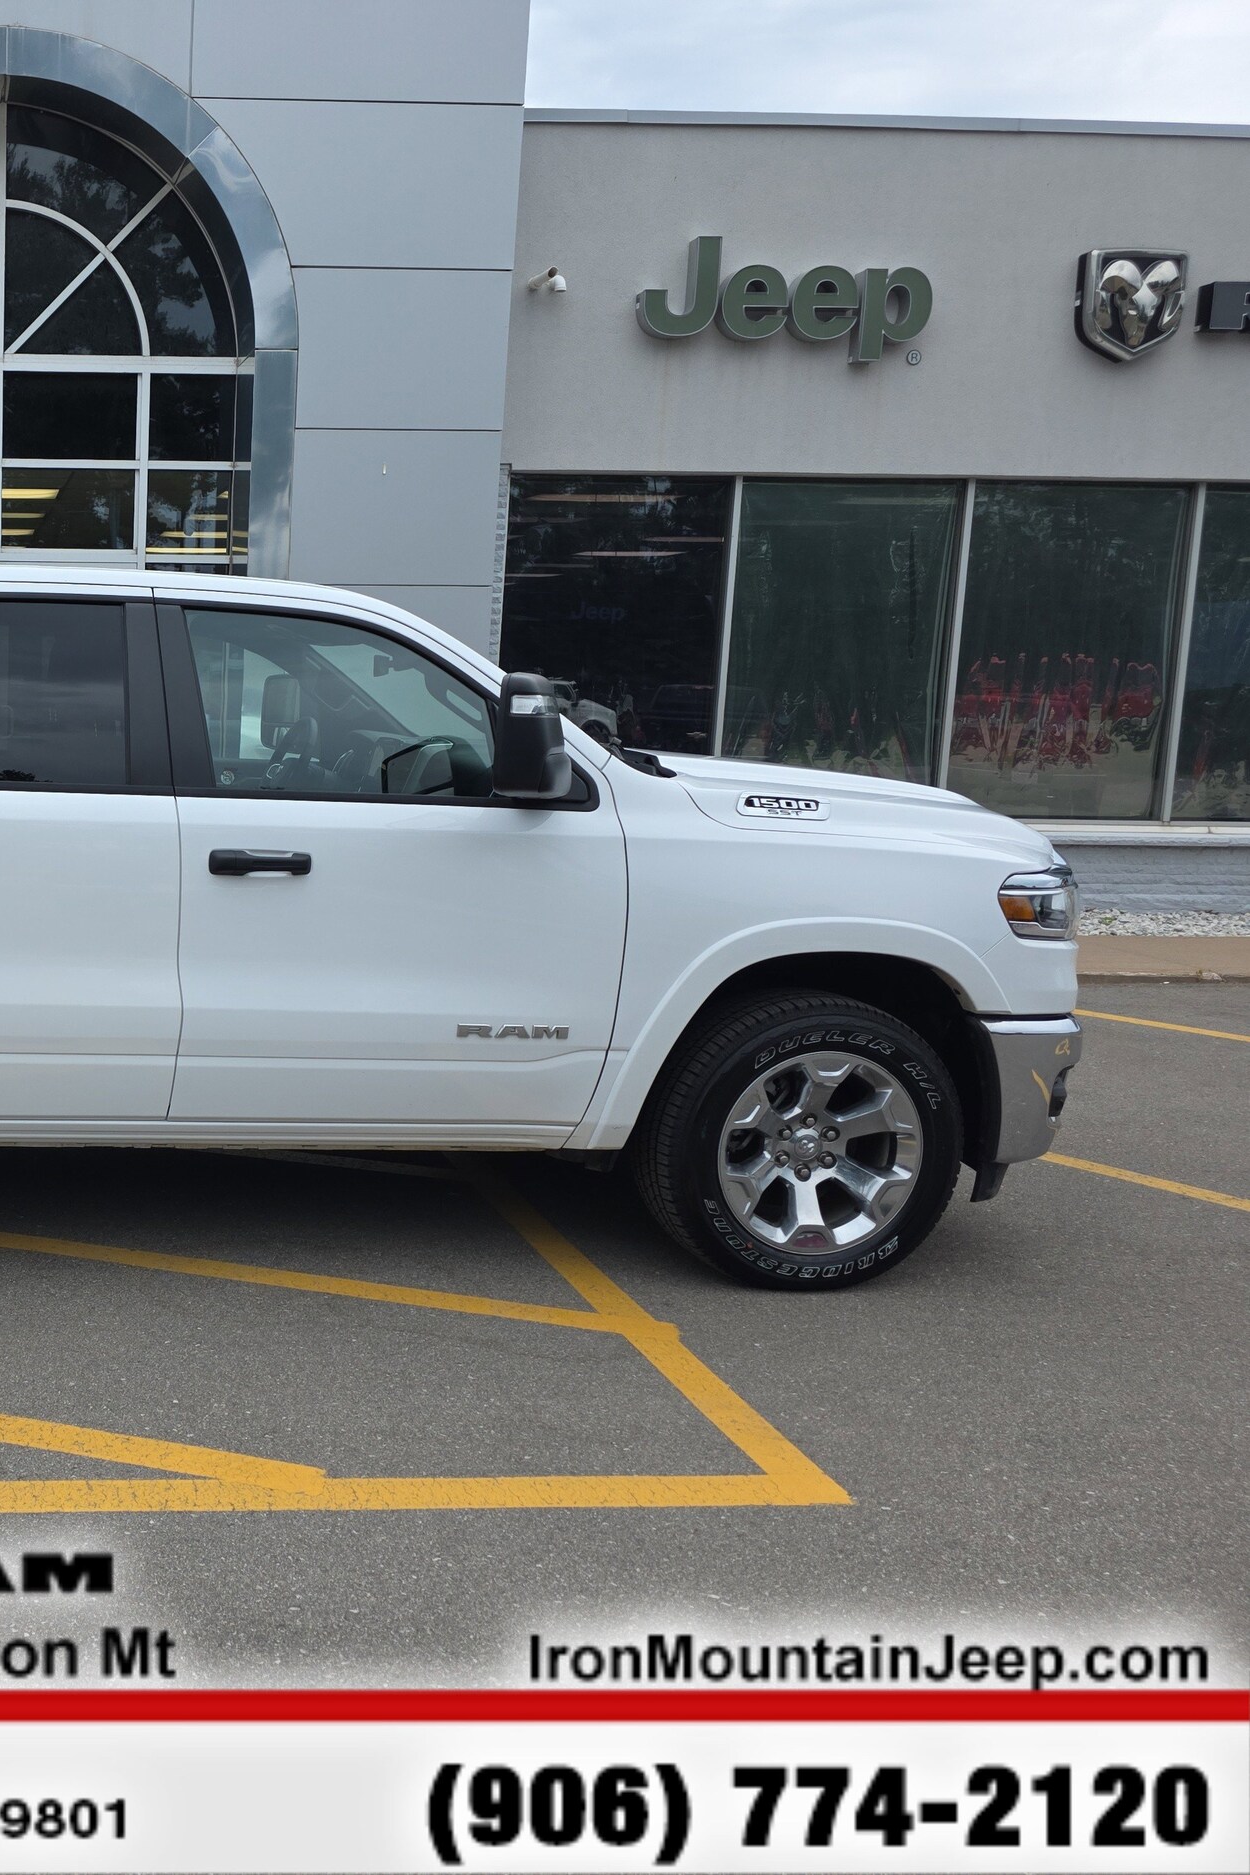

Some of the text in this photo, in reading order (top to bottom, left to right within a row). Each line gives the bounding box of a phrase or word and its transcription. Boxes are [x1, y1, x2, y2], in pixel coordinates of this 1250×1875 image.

[636, 235, 933, 364] Jeep
[749, 797, 817, 810] 1500
[456, 1023, 570, 1039] RAM
[755, 1030, 941, 1110] DUELER H/L
[703, 1198, 899, 1278] BRIDGESTONE
